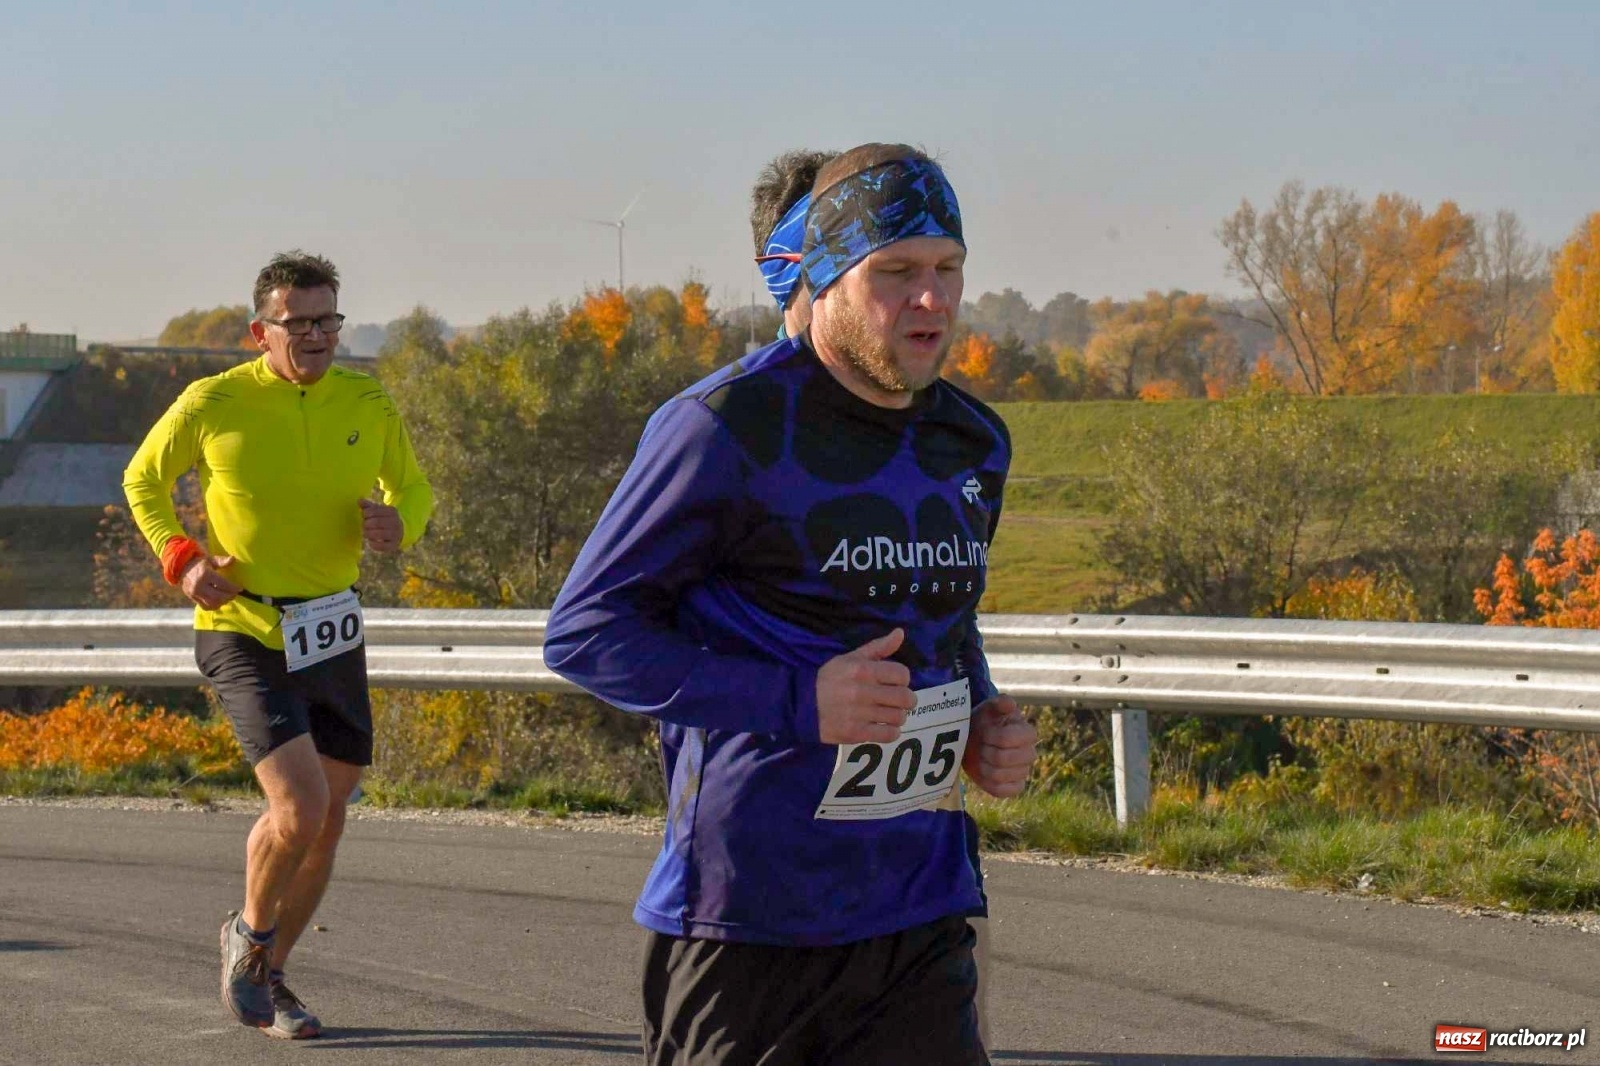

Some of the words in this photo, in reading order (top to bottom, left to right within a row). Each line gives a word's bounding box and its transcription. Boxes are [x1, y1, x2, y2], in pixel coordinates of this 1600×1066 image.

[868, 581, 972, 597] SPORTS
[291, 612, 359, 656] 190
[834, 729, 961, 798] 205
